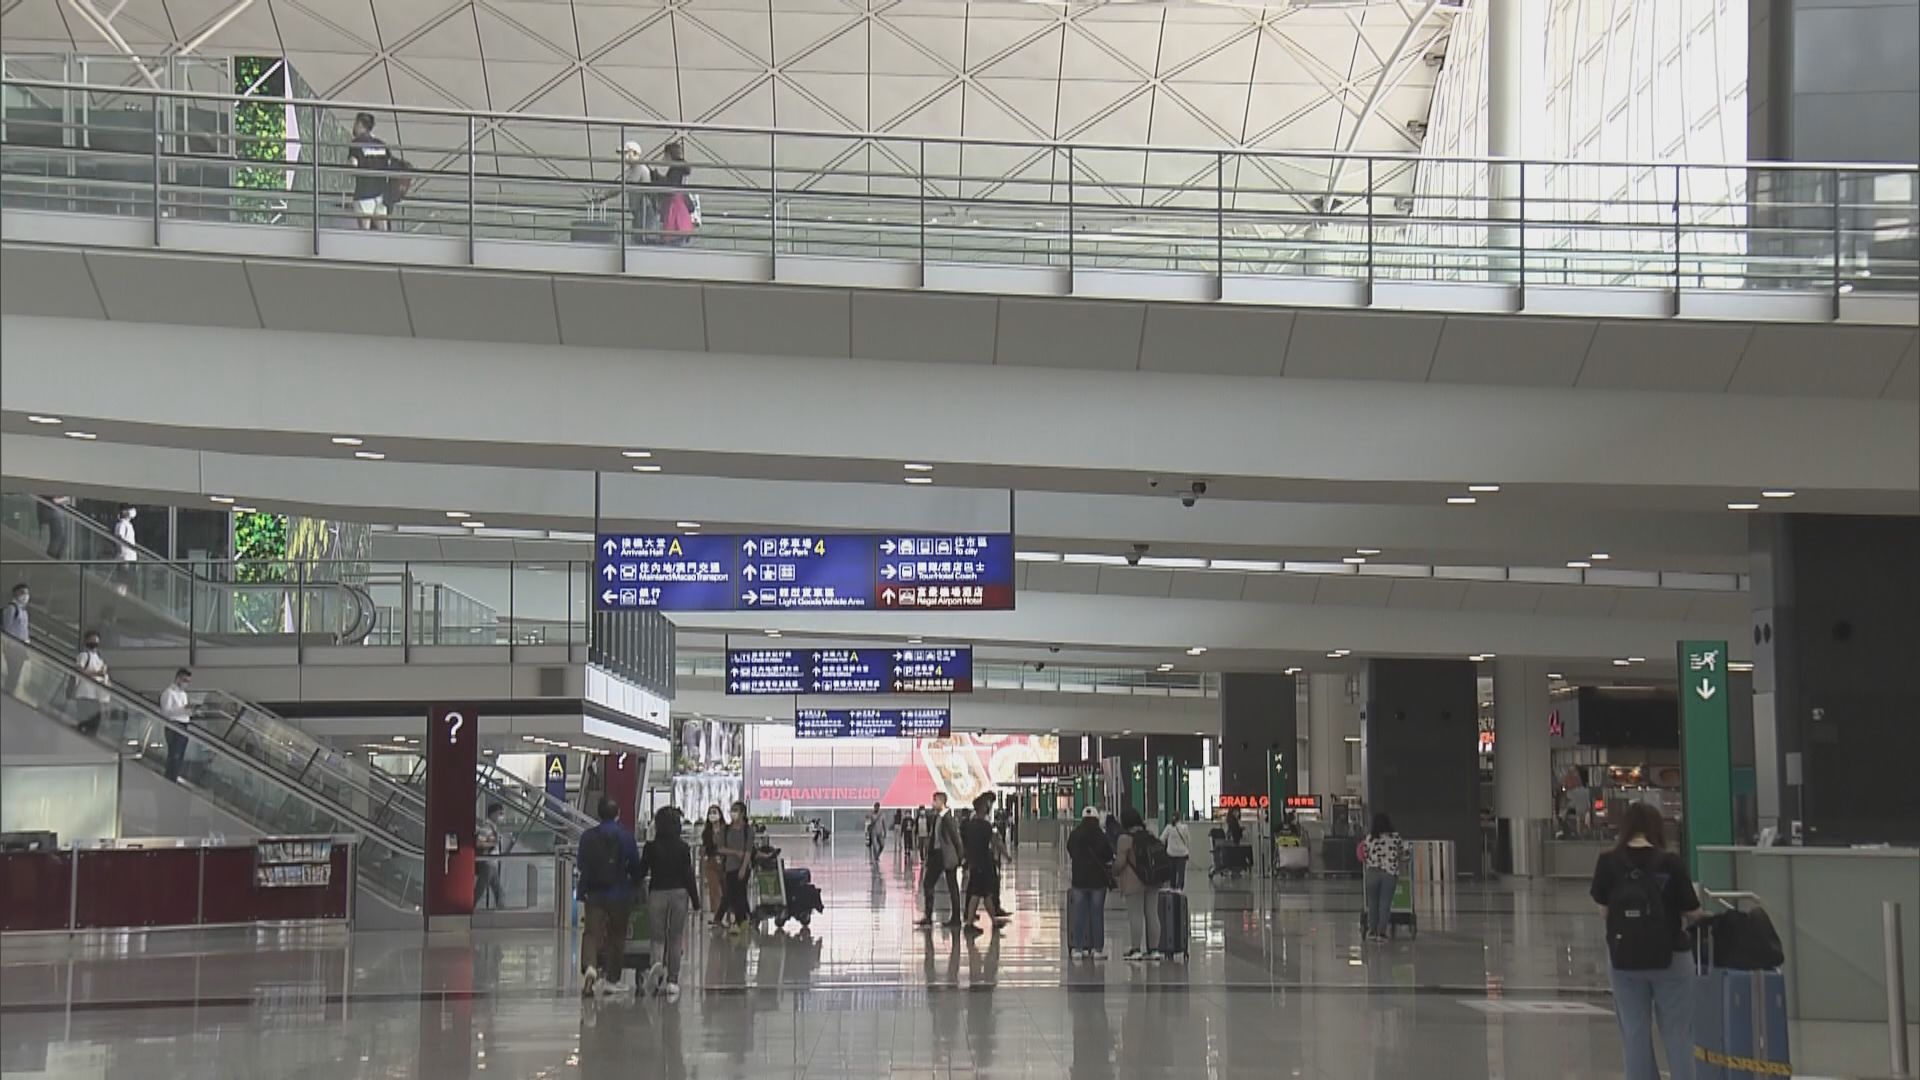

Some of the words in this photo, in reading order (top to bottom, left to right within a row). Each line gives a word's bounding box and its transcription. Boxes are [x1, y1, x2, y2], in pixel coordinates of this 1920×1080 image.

[668, 538, 683, 556] A
[779, 548, 791, 556] Car
[792, 548, 808, 556] Park
[813, 539, 826, 556] 4
[965, 547, 978, 557] city
[621, 548, 648, 557] Arrivals
[650, 548, 664, 556] Hall
[639, 598, 657, 606] Bank
[779, 598, 796, 607] Light
[848, 598, 865, 606] Area
[938, 597, 962, 607] Airport
[963, 597, 983, 606] Hotel
[849, 651, 859, 662] A
[935, 665, 943, 676] 4
[549, 756, 563, 774] A
[1220, 796, 1247, 808] GRAB
[1249, 796, 1257, 807] &
